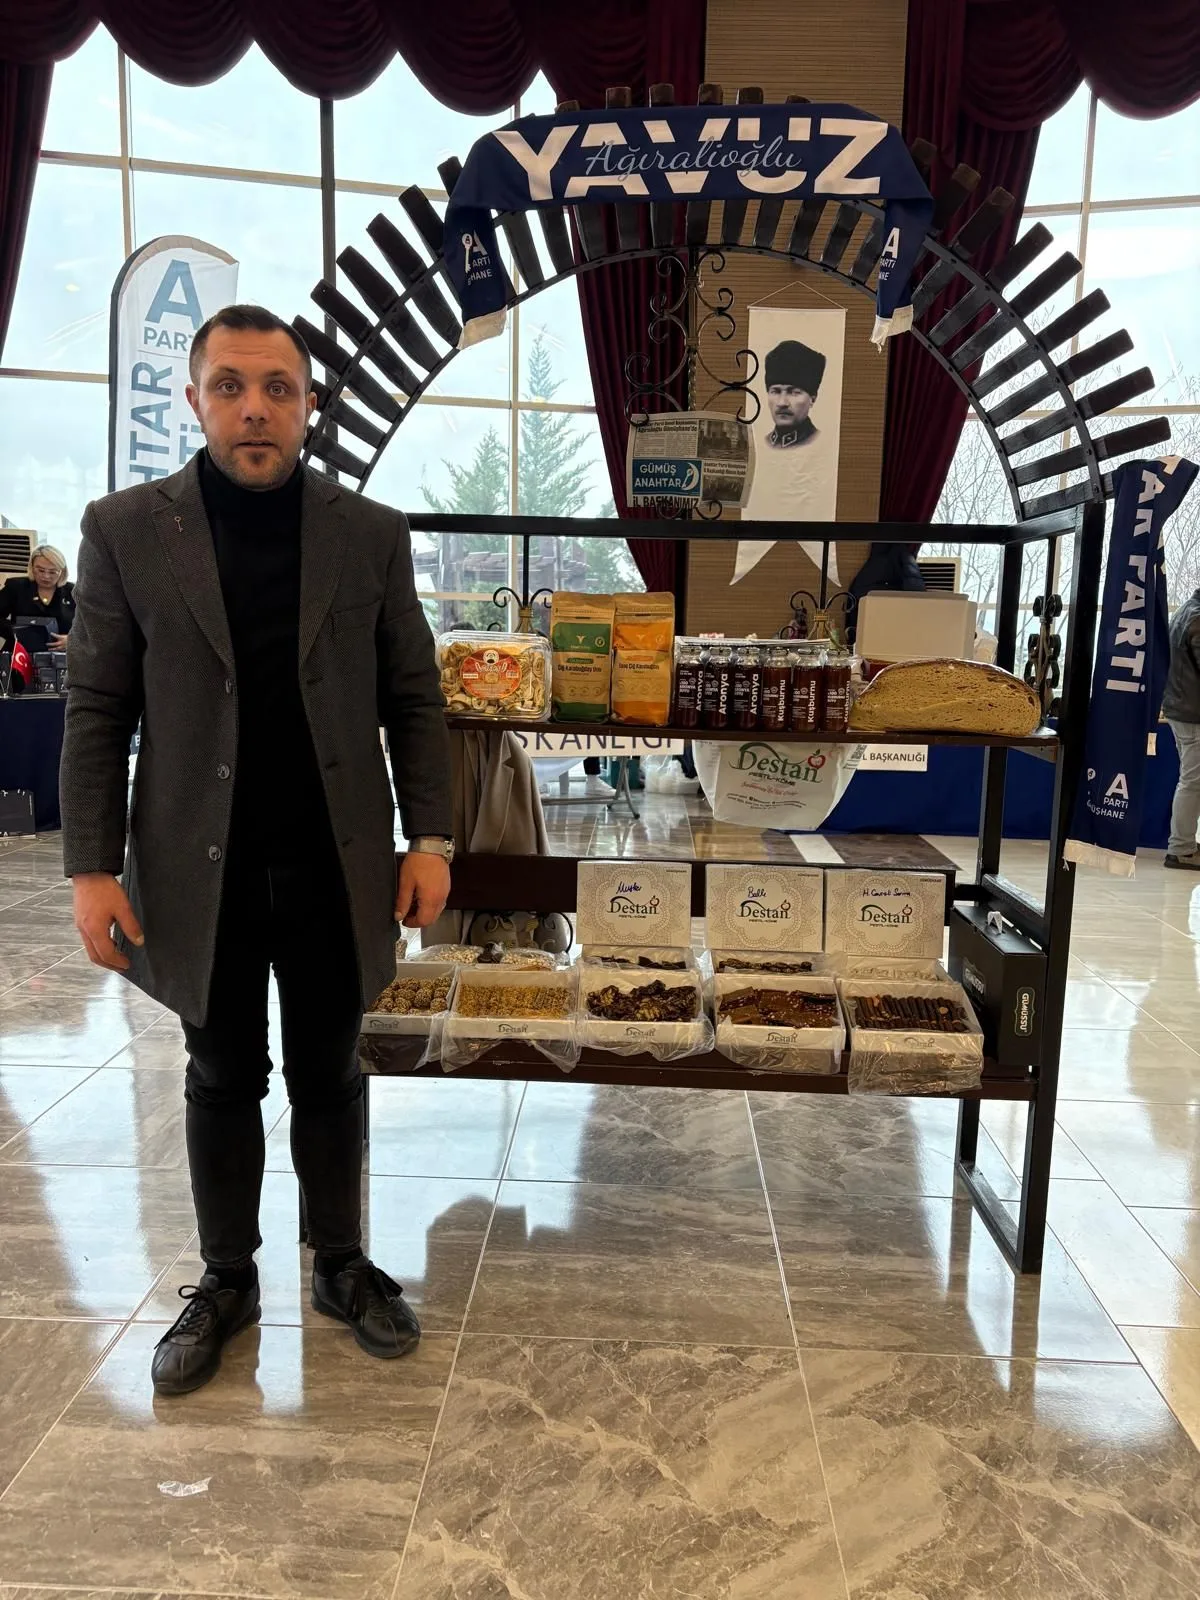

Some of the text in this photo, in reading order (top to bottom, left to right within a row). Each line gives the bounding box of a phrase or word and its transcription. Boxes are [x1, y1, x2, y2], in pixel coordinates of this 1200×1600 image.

[491, 117, 889, 200] YAVUZ
[585, 136, 802, 181] Ağıralioğlu
[145, 259, 204, 330] A
[143, 326, 194, 352] PAR
[130, 361, 173, 483] HTAR
[634, 478, 682, 488] ANAHTAR
[640, 463, 676, 476] GÜMÜŞ
[696, 670, 704, 712] Aronya
[719, 673, 730, 715] Aronya
[750, 673, 760, 715] Aronya
[777, 679, 786, 722] Kuşburnu
[807, 680, 816, 723] Kuşburnu
[728, 741, 824, 783] Destan
[869, 751, 926, 763] BAŞKANLIĞI
[1105, 773, 1129, 800] A
[607, 895, 660, 915] Destan
[737, 900, 791, 919] Destan
[858, 904, 913, 924] Destan
